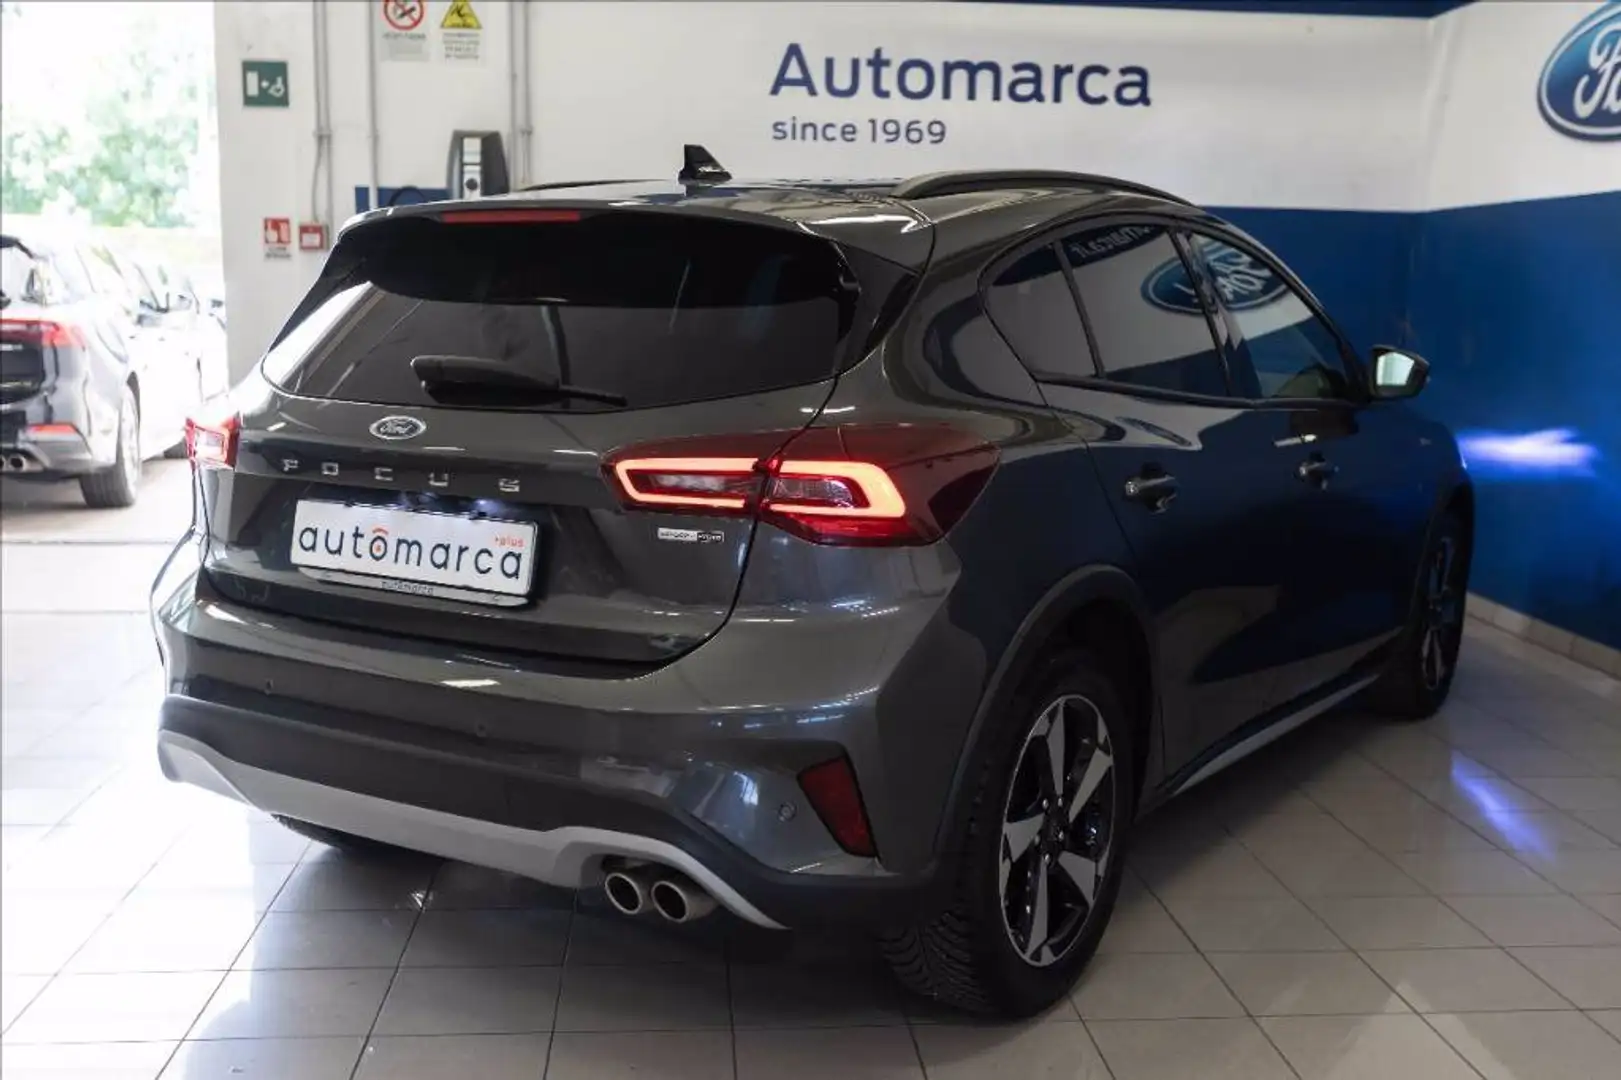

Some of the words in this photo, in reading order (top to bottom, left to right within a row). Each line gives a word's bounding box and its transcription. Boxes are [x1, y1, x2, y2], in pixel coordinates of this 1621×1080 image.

[769, 42, 1152, 107] Automarca
[772, 116, 857, 142] since
[868, 119, 946, 144] 1969
[283, 458, 521, 493] FOCUS
